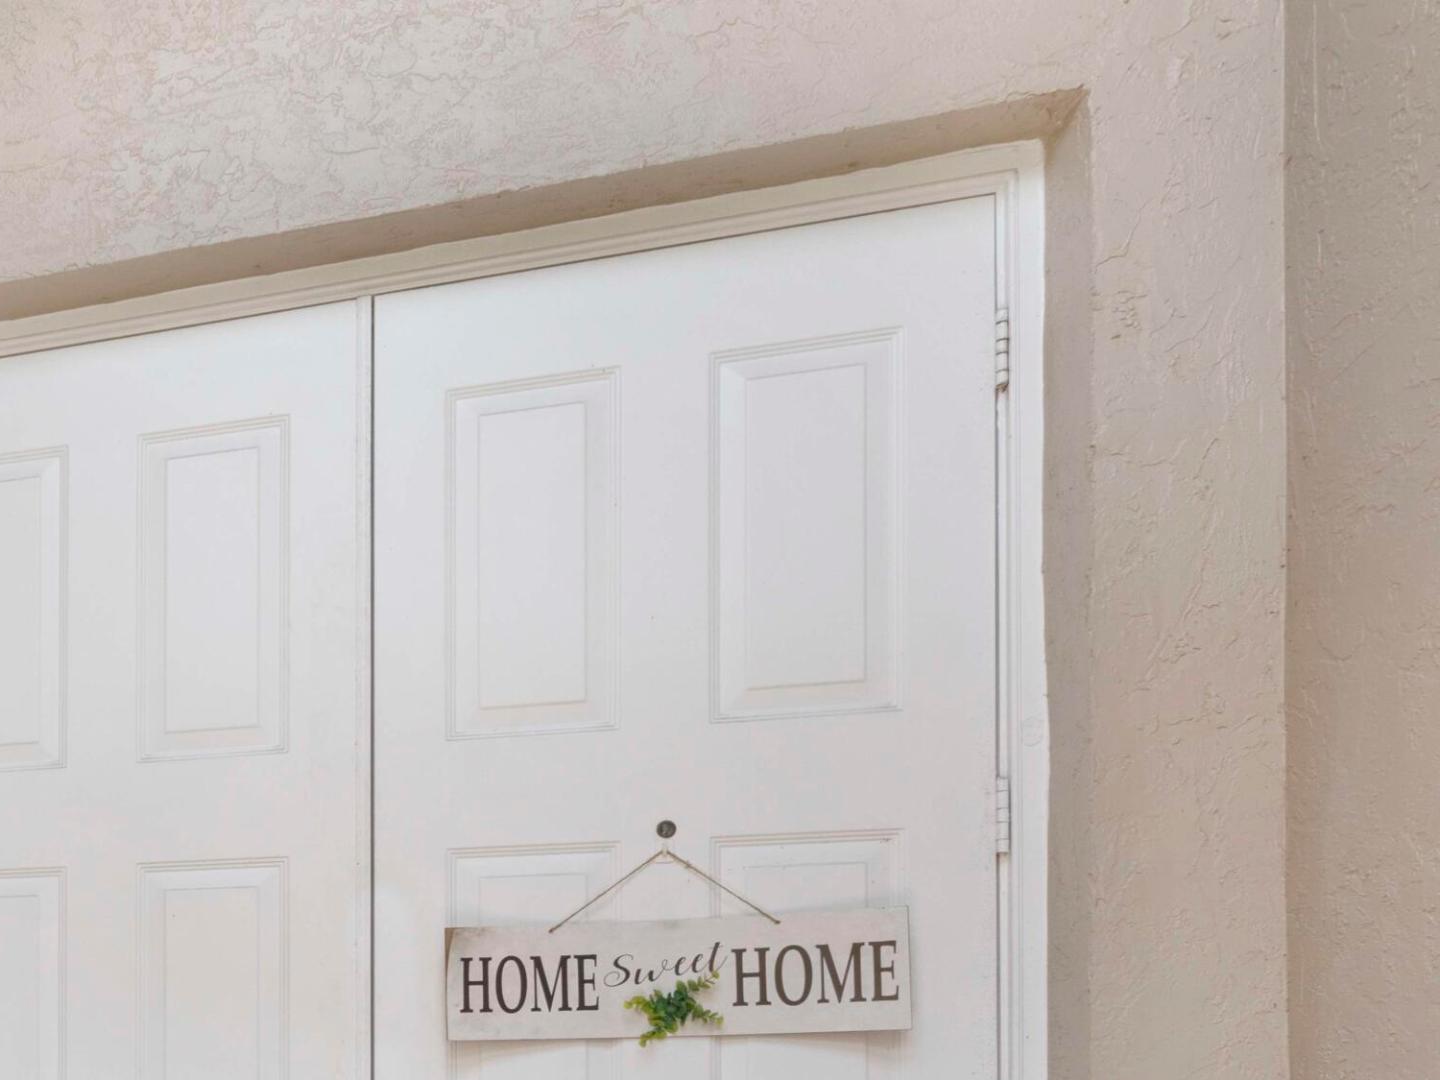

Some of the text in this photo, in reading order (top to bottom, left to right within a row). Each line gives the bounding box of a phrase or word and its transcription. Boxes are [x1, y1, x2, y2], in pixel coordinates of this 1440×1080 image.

[459, 940, 900, 1014] HOME Sweet HOME
